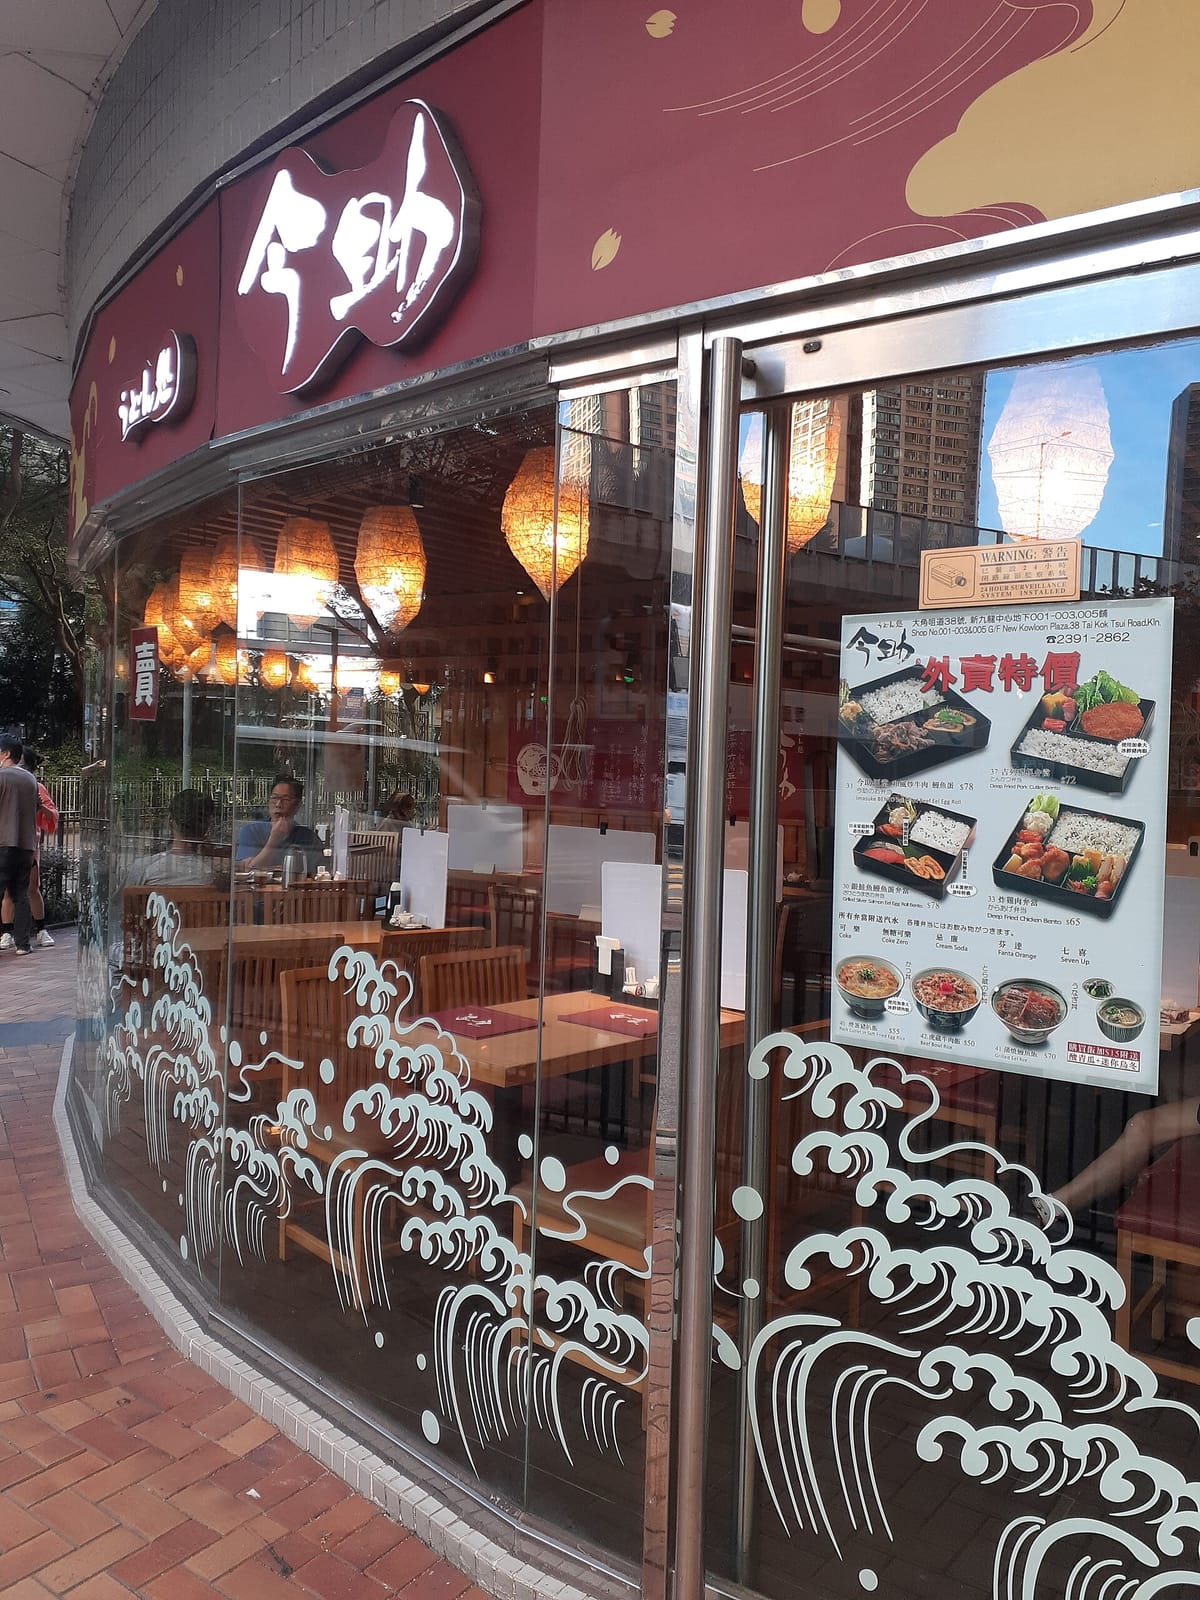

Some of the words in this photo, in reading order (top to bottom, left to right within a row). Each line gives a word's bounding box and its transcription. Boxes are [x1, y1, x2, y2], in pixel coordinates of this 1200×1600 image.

[238, 112, 454, 375] 今助
[981, 550, 1037, 563] WARNING:
[980, 591, 1012, 599] SYSTEM
[912, 629, 928, 637] Shop
[1003, 624, 1017, 632] New
[1019, 622, 1049, 631] Kowloon
[1082, 620, 1093, 629] Tai
[1094, 619, 1108, 629] Kok
[1111, 619, 1126, 628] Tsui
[1057, 631, 1130, 644] 2391-2862
[135, 642, 155, 707] 賣
[920, 650, 1082, 694] 外賣特價
[959, 782, 974, 792] $78
[927, 901, 941, 910] $78
[987, 912, 1003, 921] Deep
[1019, 915, 1042, 923] Chicken
[1043, 917, 1062, 925] Bento
[1066, 917, 1081, 926] $65
[935, 942, 953, 951] Cream
[953, 944, 968, 952] Soda
[998, 949, 1014, 957] Fanta
[1015, 951, 1037, 960] Orange
[1061, 956, 1079, 965] Seven
[1080, 958, 1090, 966] Up
